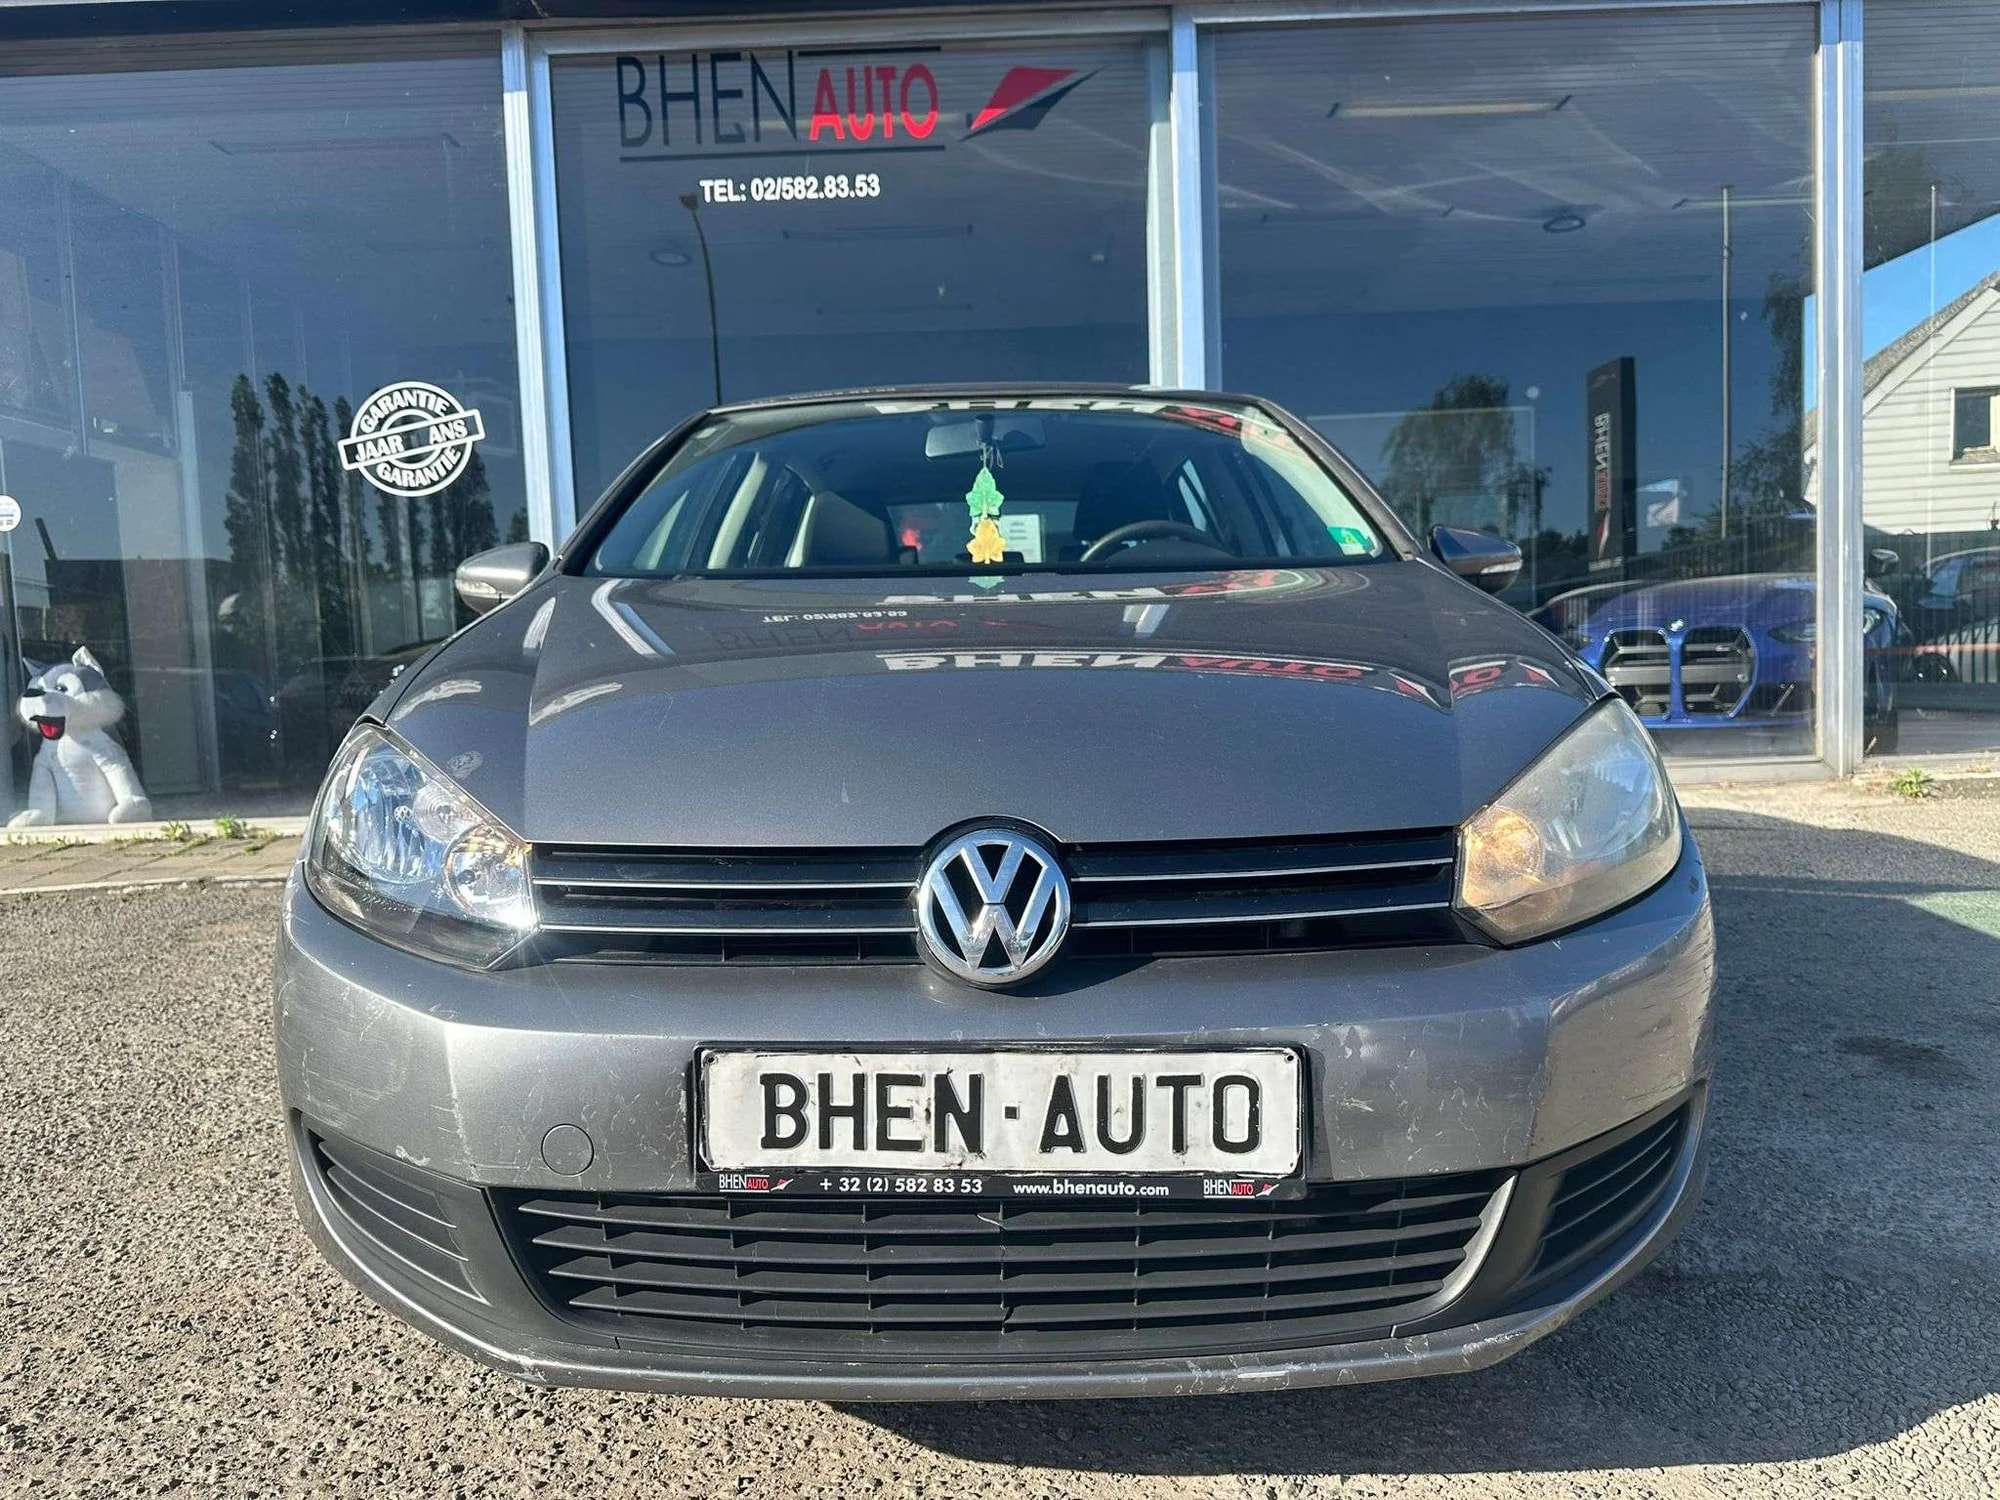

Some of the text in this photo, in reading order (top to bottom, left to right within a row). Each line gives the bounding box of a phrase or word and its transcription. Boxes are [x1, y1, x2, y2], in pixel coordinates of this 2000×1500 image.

[616, 50, 939, 147] BHEN AUTO
[700, 174, 880, 203] TEL: 02/582.83.53
[360, 389, 450, 433] GARANTIE
[355, 419, 468, 462] JAAR ANS
[376, 447, 461, 487] GARANTIE
[759, 1071, 985, 1152] BHEN
[1038, 1073, 1262, 1154] AUTO
[838, 1178, 860, 1192] 32
[867, 1177, 889, 1194] (2)
[894, 1178, 928, 1193] 582
[933, 1178, 955, 1193] 83
[960, 1178, 983, 1194] 53
[1012, 1179, 1170, 1197] www.bhenauto.com
